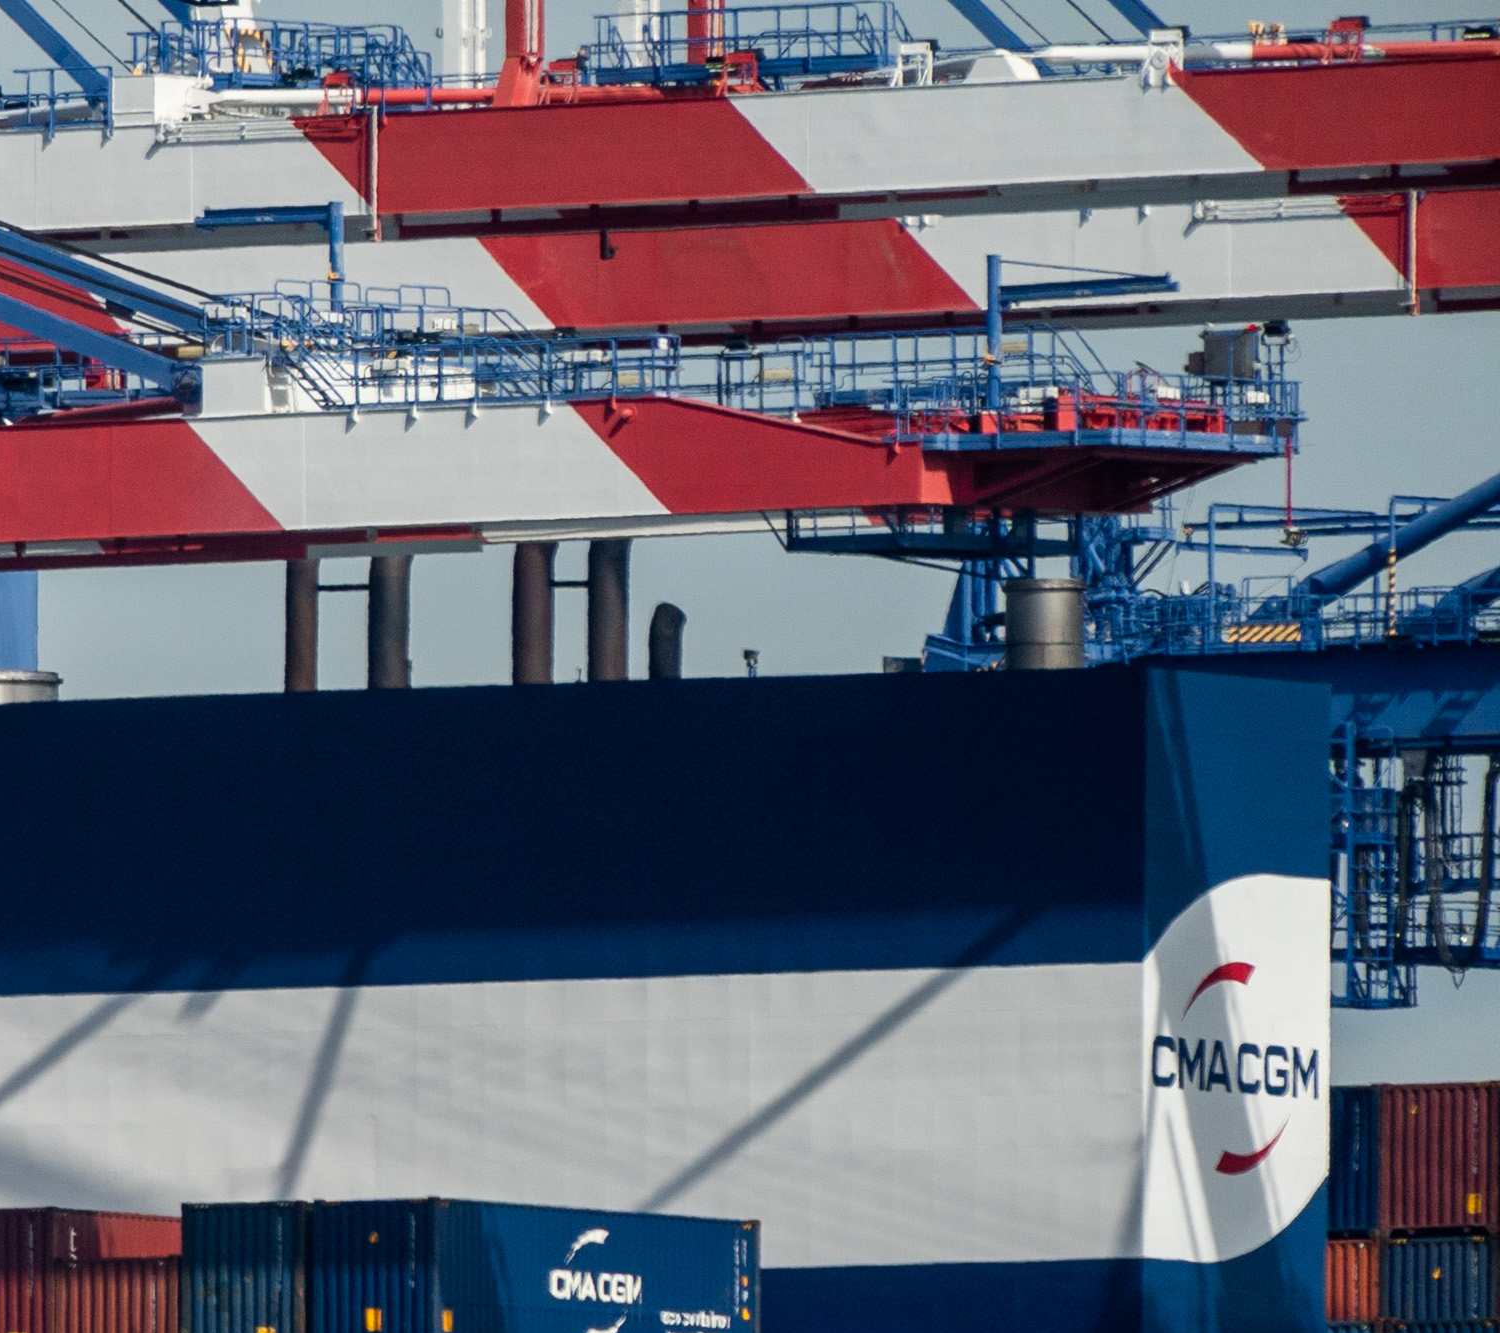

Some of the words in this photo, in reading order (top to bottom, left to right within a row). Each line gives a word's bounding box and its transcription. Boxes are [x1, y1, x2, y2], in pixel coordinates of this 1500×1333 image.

[1151, 1034, 1232, 1093] CMA
[1236, 1042, 1319, 1100] CGM
[548, 1267, 598, 1302] CMA
[598, 1272, 642, 1305] CGM
